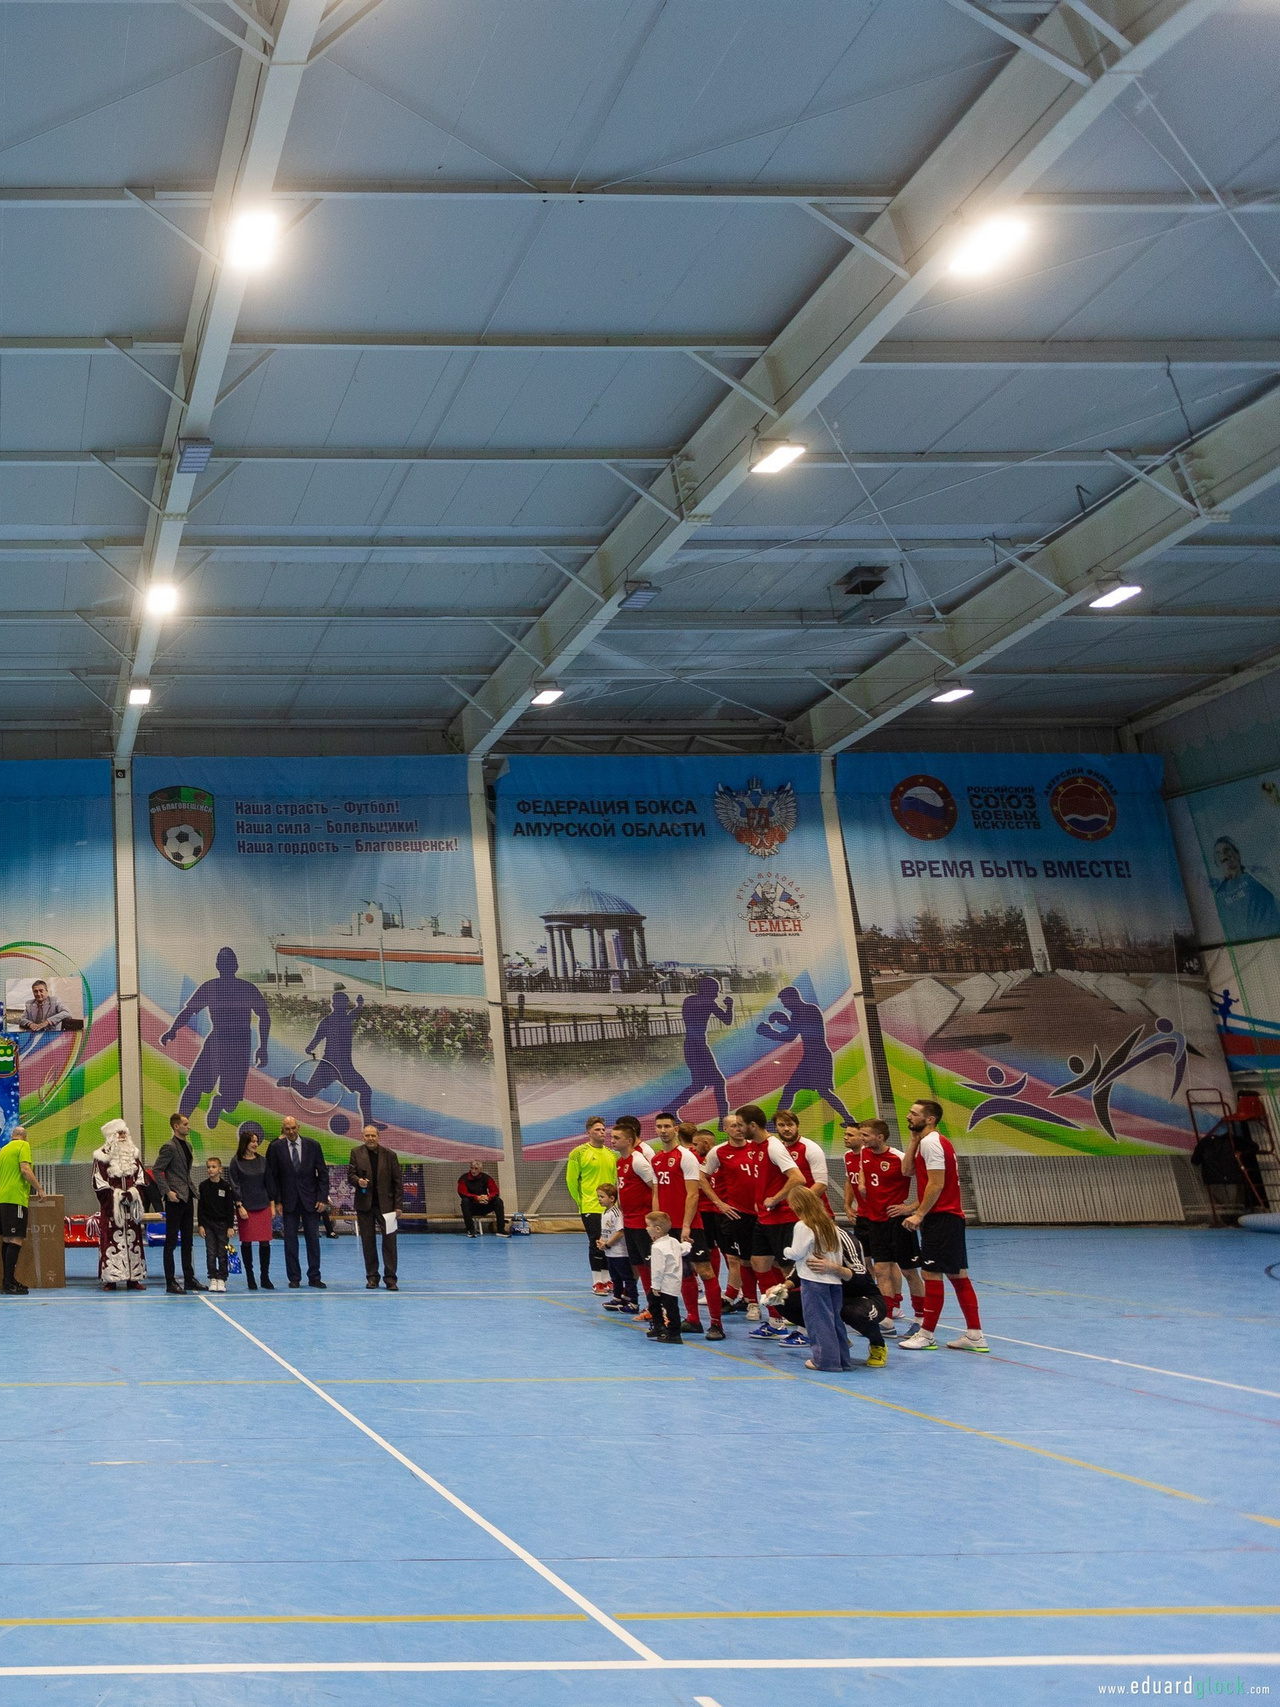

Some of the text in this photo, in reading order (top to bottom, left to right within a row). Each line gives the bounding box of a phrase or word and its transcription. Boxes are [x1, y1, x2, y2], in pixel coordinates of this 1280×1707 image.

[966, 785, 1035, 793] РОССИЙСКИЙ
[235, 801, 271, 815] Наша
[275, 803, 329, 816] страсть
[344, 800, 400, 816] Футбол!
[516, 800, 697, 817] ФЕДЕРАЦИЯ БОКСА
[969, 794, 1037, 809] СОЮЗ
[971, 810, 1039, 820] БОЕВЫХ
[236, 820, 272, 835] Наша
[276, 823, 311, 834] сила
[326, 819, 419, 835] Болельщики!
[513, 819, 706, 837] АМУРСКОЙ ОБЛАСТИ
[973, 821, 1042, 830] ИСКУССТВ
[237, 839, 274, 854] Наша
[278, 841, 339, 855] гордость
[354, 838, 459, 853] Благовещенск!
[899, 860, 1132, 878] ВРЕМЯ БЫТЬ ВМЕСТЕ!
[748, 920, 803, 932] СЕМЕН
[740, 1163, 751, 1176] 4
[657, 1171, 670, 1185] 25
[870, 1173, 879, 1187] 3
